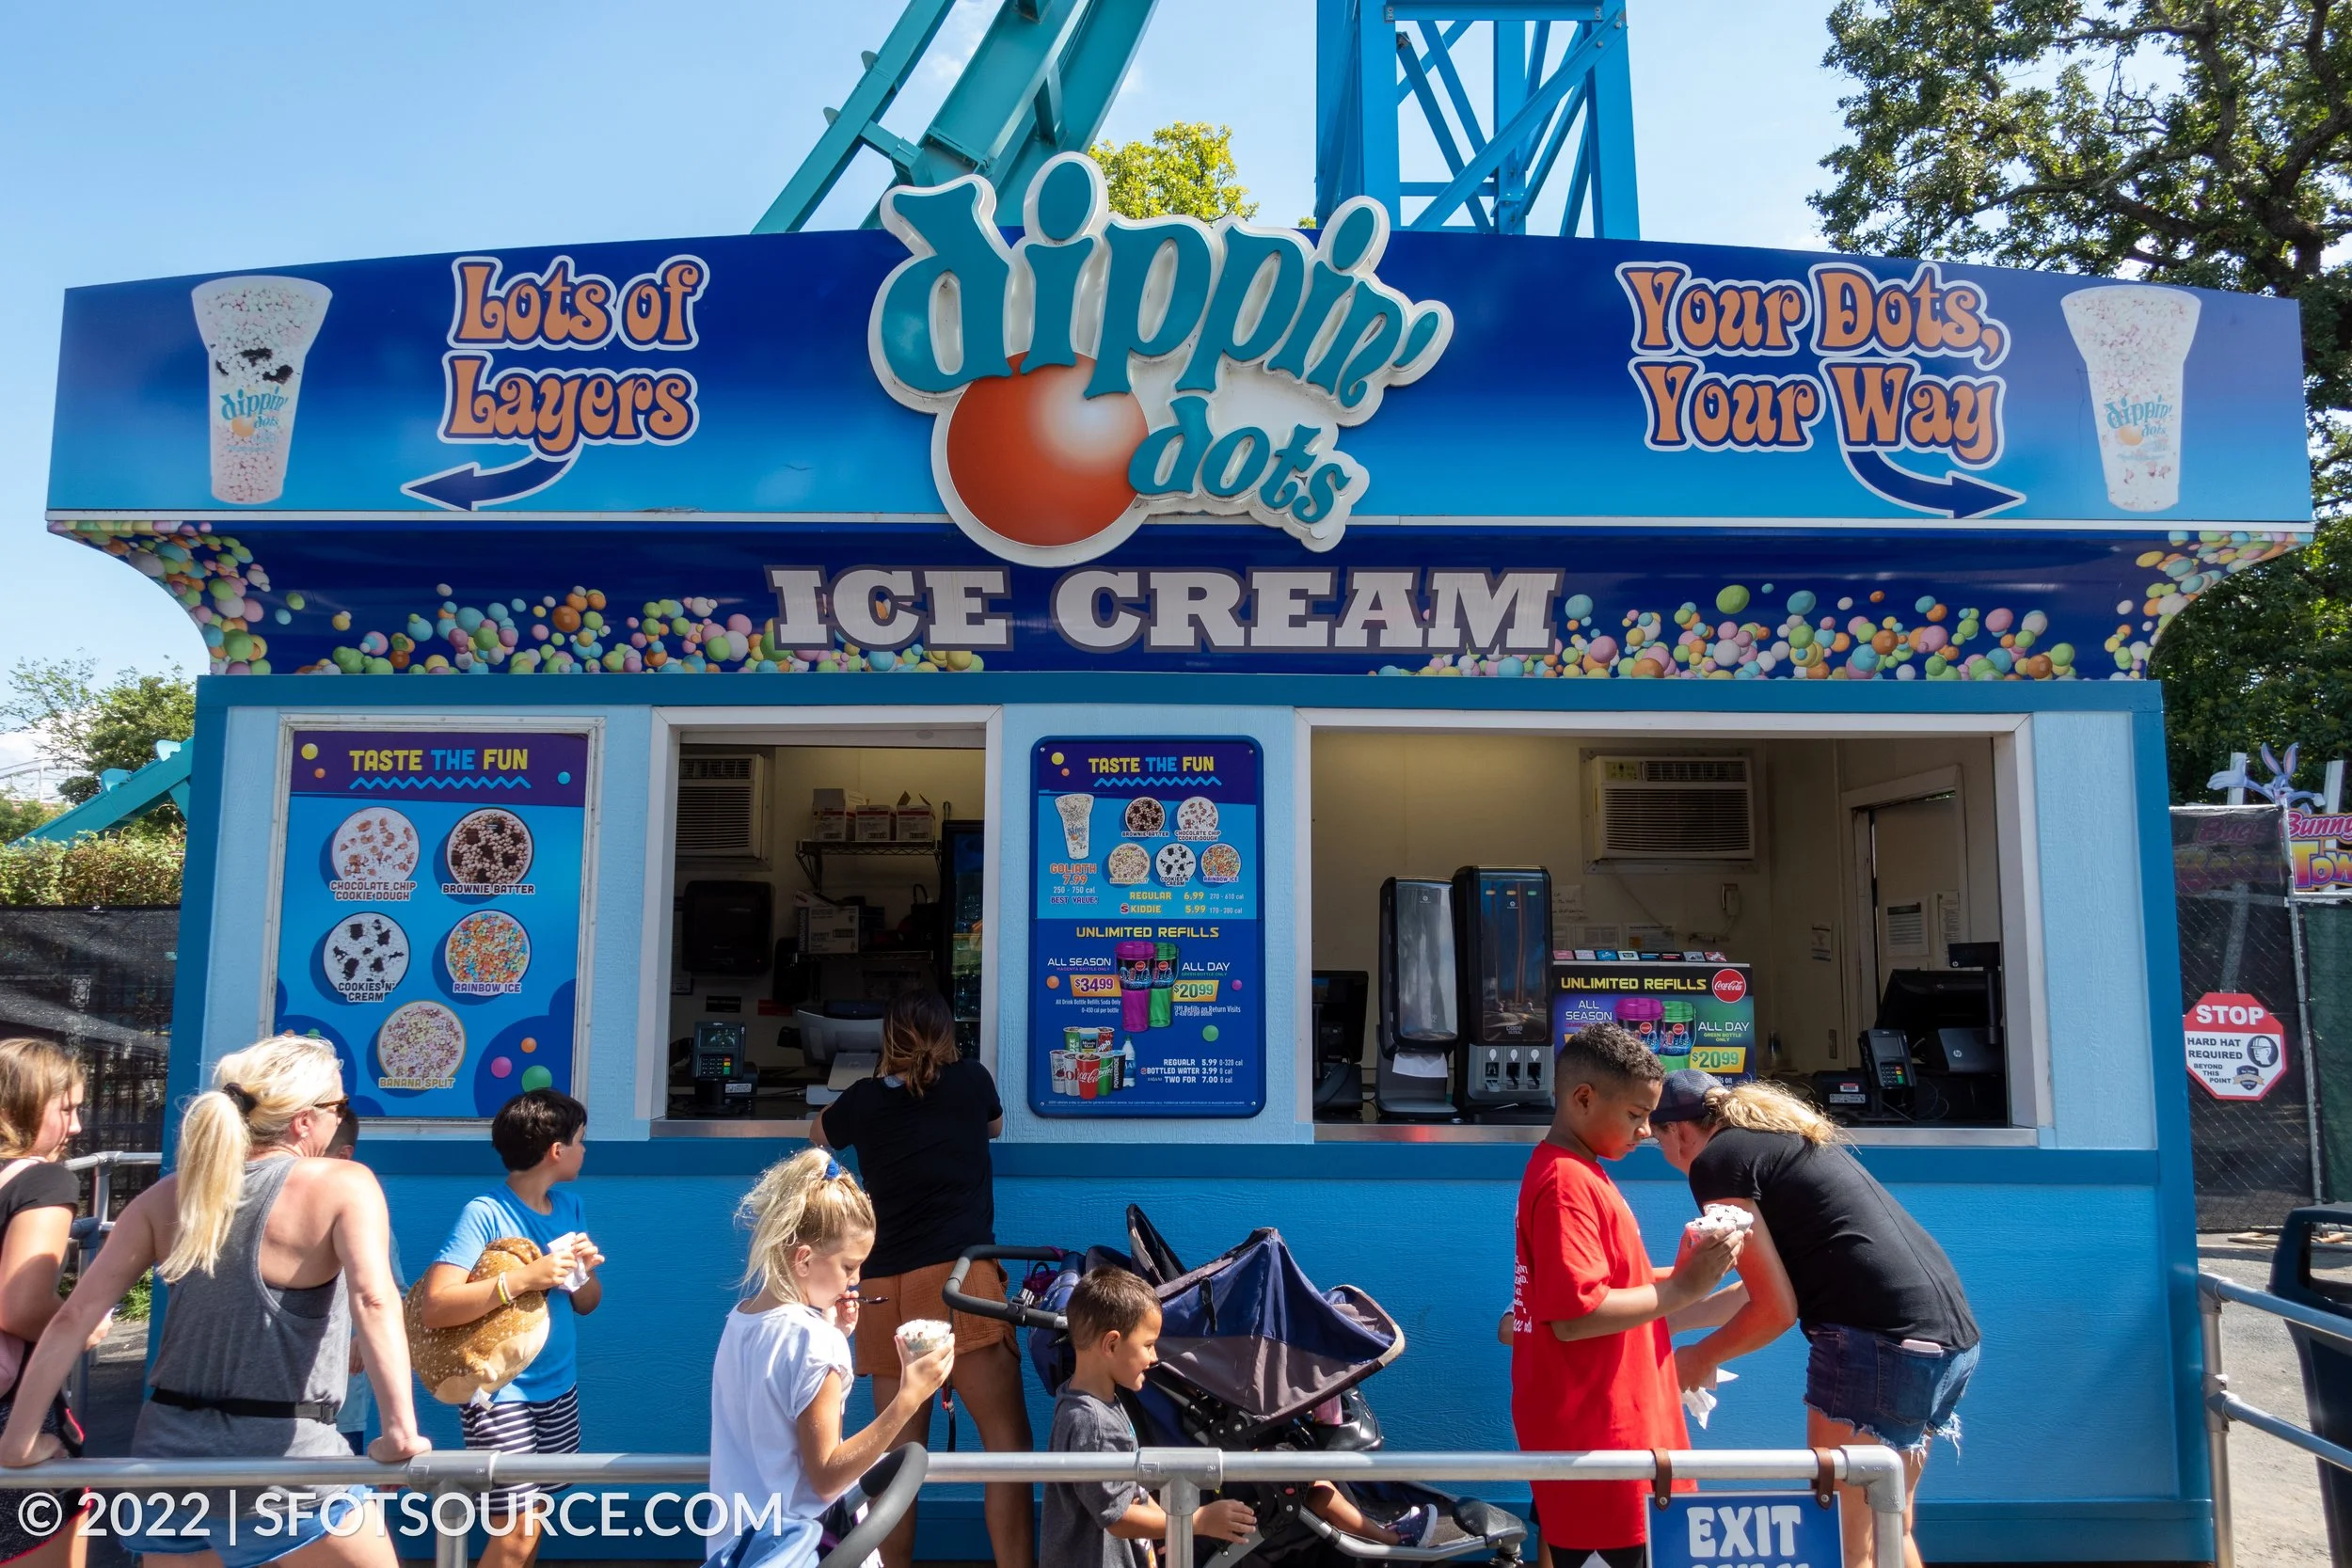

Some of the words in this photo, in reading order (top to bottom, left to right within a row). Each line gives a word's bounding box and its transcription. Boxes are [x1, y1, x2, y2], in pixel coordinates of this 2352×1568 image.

[455, 260, 611, 342] Lots
[622, 260, 702, 342] of
[1622, 264, 1805, 353] Your
[1817, 263, 2006, 362] Dots,
[445, 356, 691, 453] Layers
[1635, 359, 1820, 448] Your
[1825, 359, 2001, 465] Way
[1128, 395, 1352, 524] dots
[769, 568, 1010, 648] ICE
[1055, 569, 1559, 649] CREAM
[349, 749, 423, 771] TASTE
[431, 749, 476, 770] THE
[483, 749, 528, 770] FUN
[1089, 757, 1140, 773] TASTE
[1146, 756, 1177, 771] THE
[1183, 756, 1215, 771] FUN
[1050, 863, 1097, 874] GOLIATH
[1063, 875, 1088, 885] 7.99
[330, 881, 391, 891] CHOCOLATE
[393, 881, 416, 891] CHIP
[443, 884, 490, 894] BROWNIE
[494, 884, 534, 894] BATTER
[336, 892, 373, 900] COOKIE
[376, 892, 409, 900] DOUGH
[1130, 892, 1171, 900] REGULAR
[1184, 892, 1204, 900] 6.99
[1131, 905, 1161, 913] KIDDIE
[1185, 905, 1206, 913] 5.99
[1076, 927, 1152, 938] UNLIMITED
[1158, 927, 1219, 938] REFILLS
[1047, 958, 1067, 966] ALL
[1069, 958, 1111, 966] SEASON
[1182, 962, 1204, 971] ALL
[1207, 962, 1231, 972] DAY
[337, 982, 381, 991] COOKIES
[453, 983, 501, 992] RAINBOW
[504, 983, 521, 993] ICE
[1561, 977, 1638, 990] UNLIMITED
[1645, 979, 1707, 990] REFILLS
[1714, 980, 1742, 991] Coca-Cola
[348, 992, 384, 1002] CREAM
[1578, 1000, 1599, 1009] ALL
[1565, 1011, 1613, 1021] SEASON
[2196, 1005, 2265, 1025] STOP
[1698, 1022, 1723, 1031] ALL
[1725, 1022, 1750, 1031] DAY
[2187, 1037, 2217, 1046] HARD
[2220, 1038, 2241, 1047] HAT
[2188, 1050, 2243, 1060] REQUIRED
[379, 1078, 423, 1087] BANANA
[425, 1078, 454, 1087] SPLIT
[1687, 1505, 1801, 1558] EXIT
